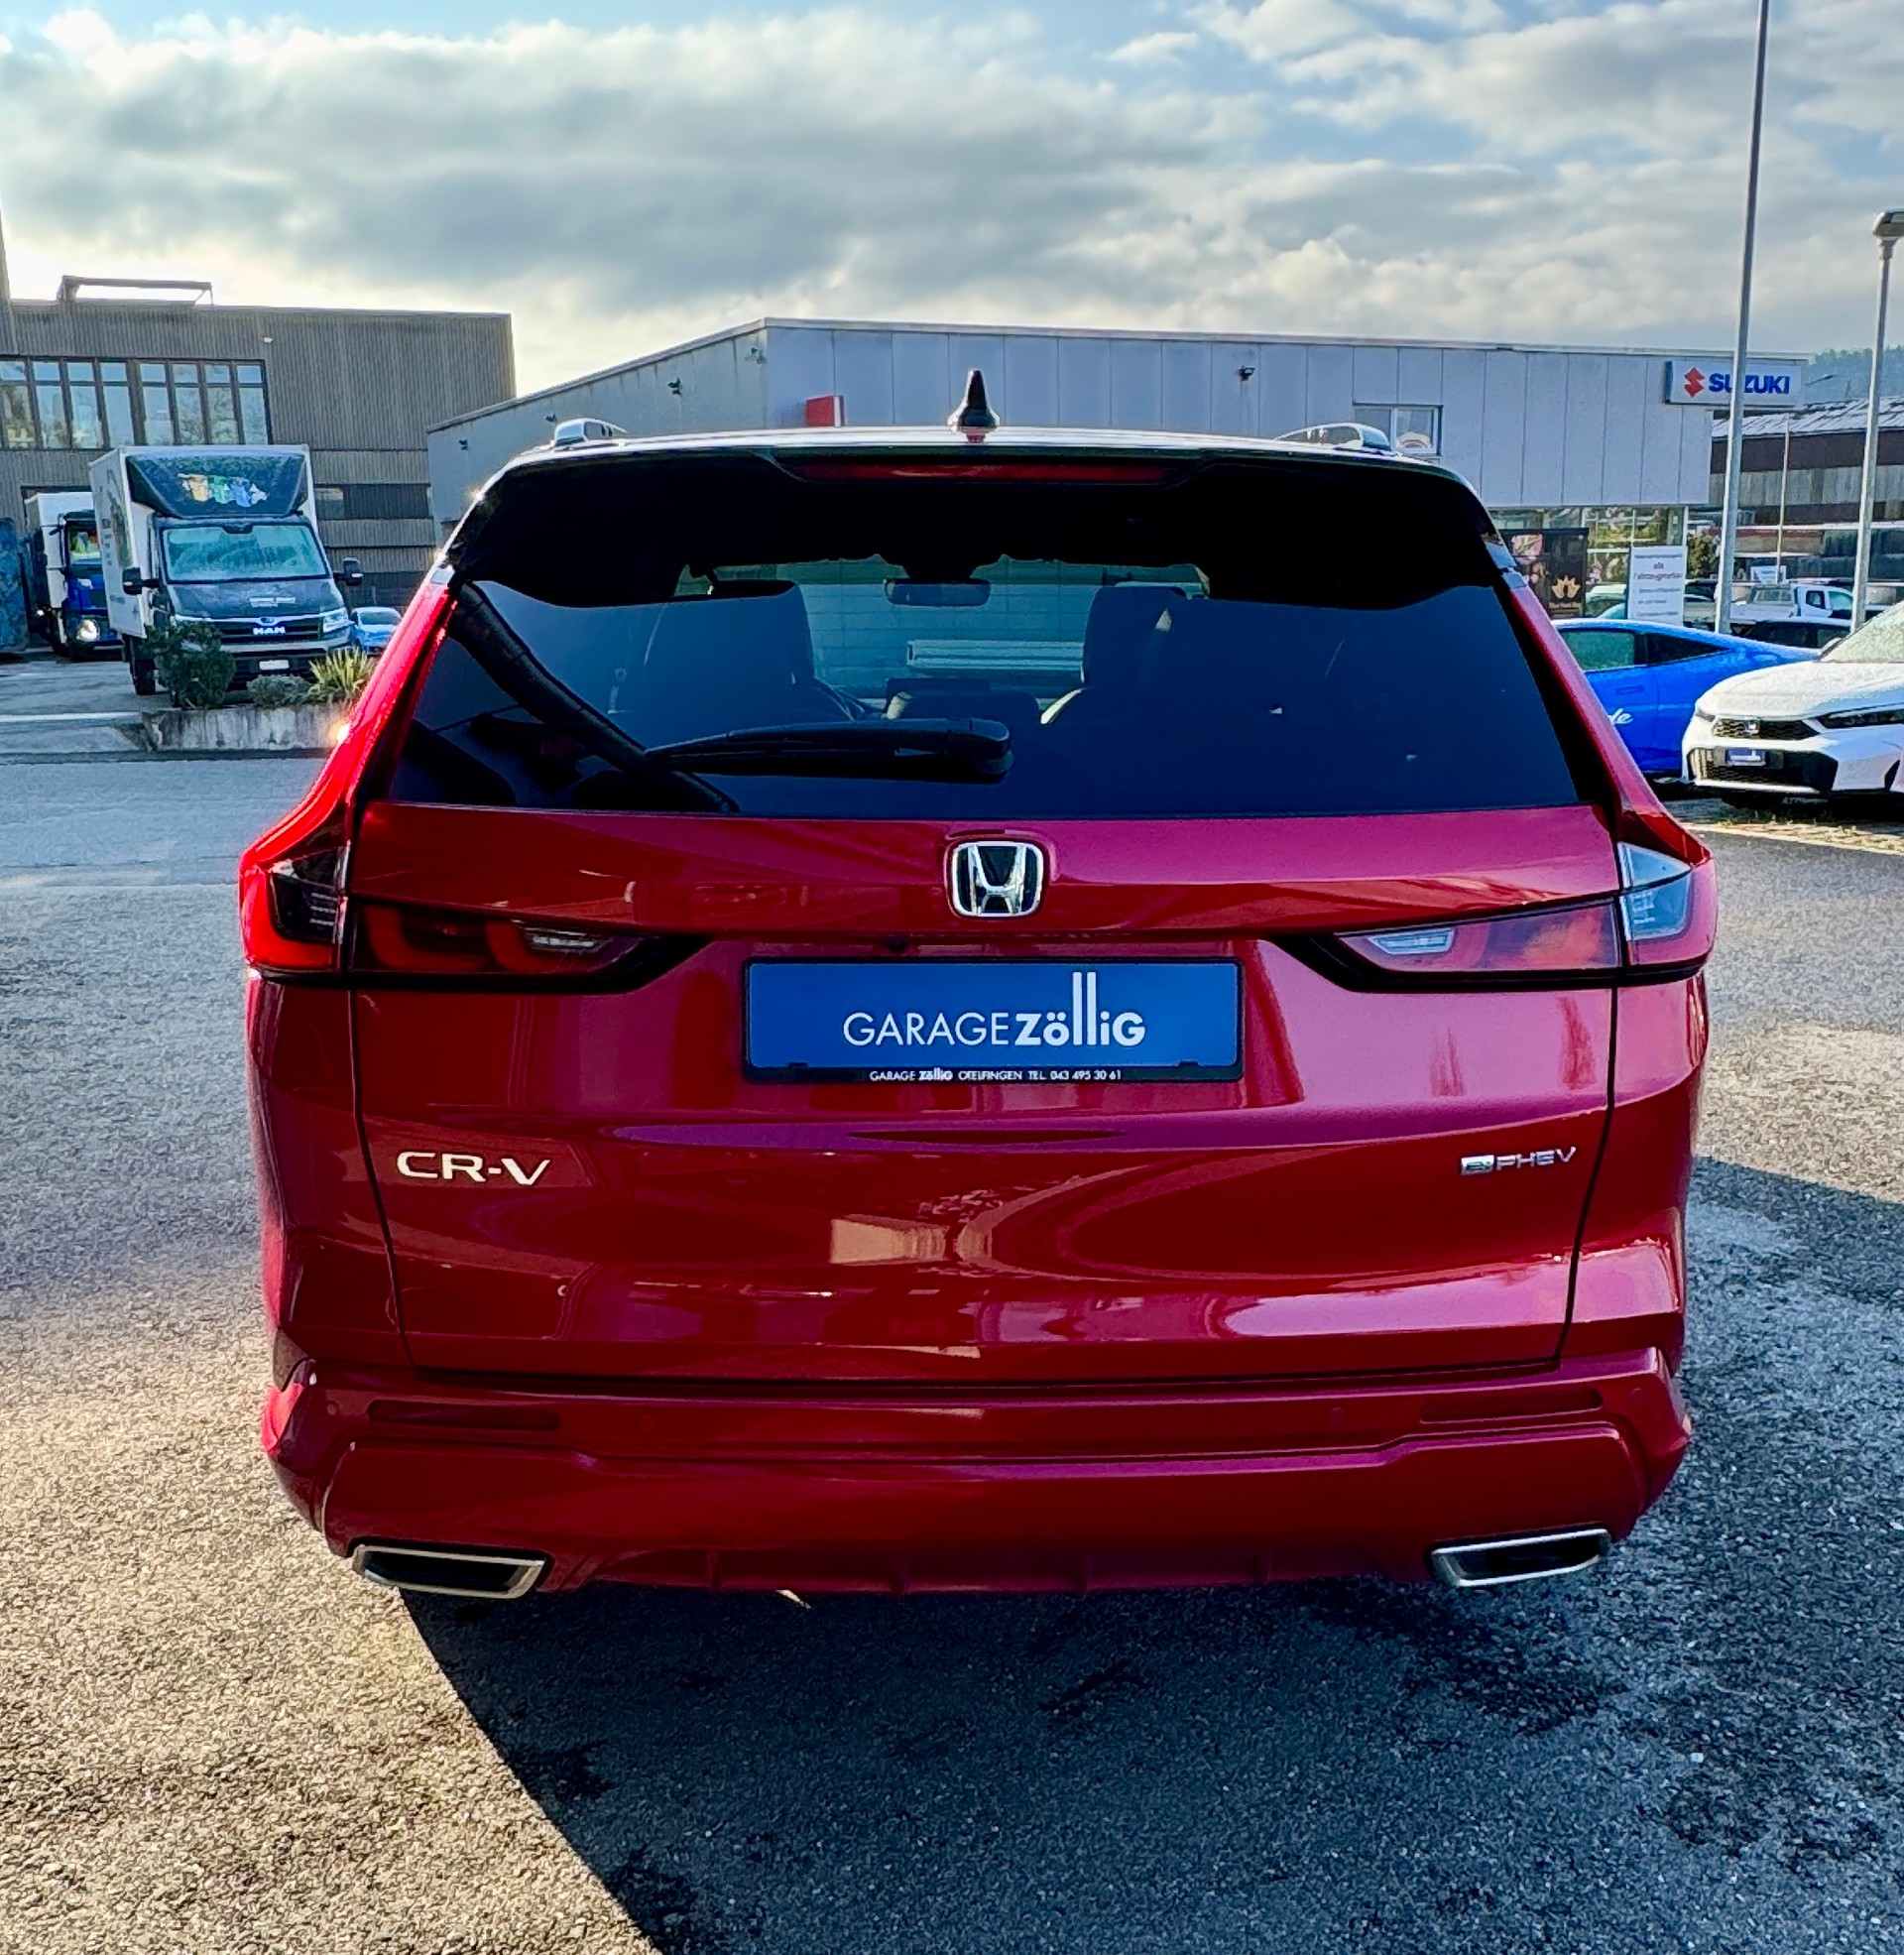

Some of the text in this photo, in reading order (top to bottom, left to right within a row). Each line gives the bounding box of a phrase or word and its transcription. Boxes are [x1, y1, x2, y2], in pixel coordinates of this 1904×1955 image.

[253, 626, 286, 636] MAN
[843, 1012, 1010, 1046] GARAGE
[870, 1070, 915, 1081] GARAGE
[1050, 1070, 1069, 1081] 043
[1072, 1070, 1091, 1081] 495
[1094, 1070, 1108, 1081] 30
[397, 1151, 550, 1186] CR-V
